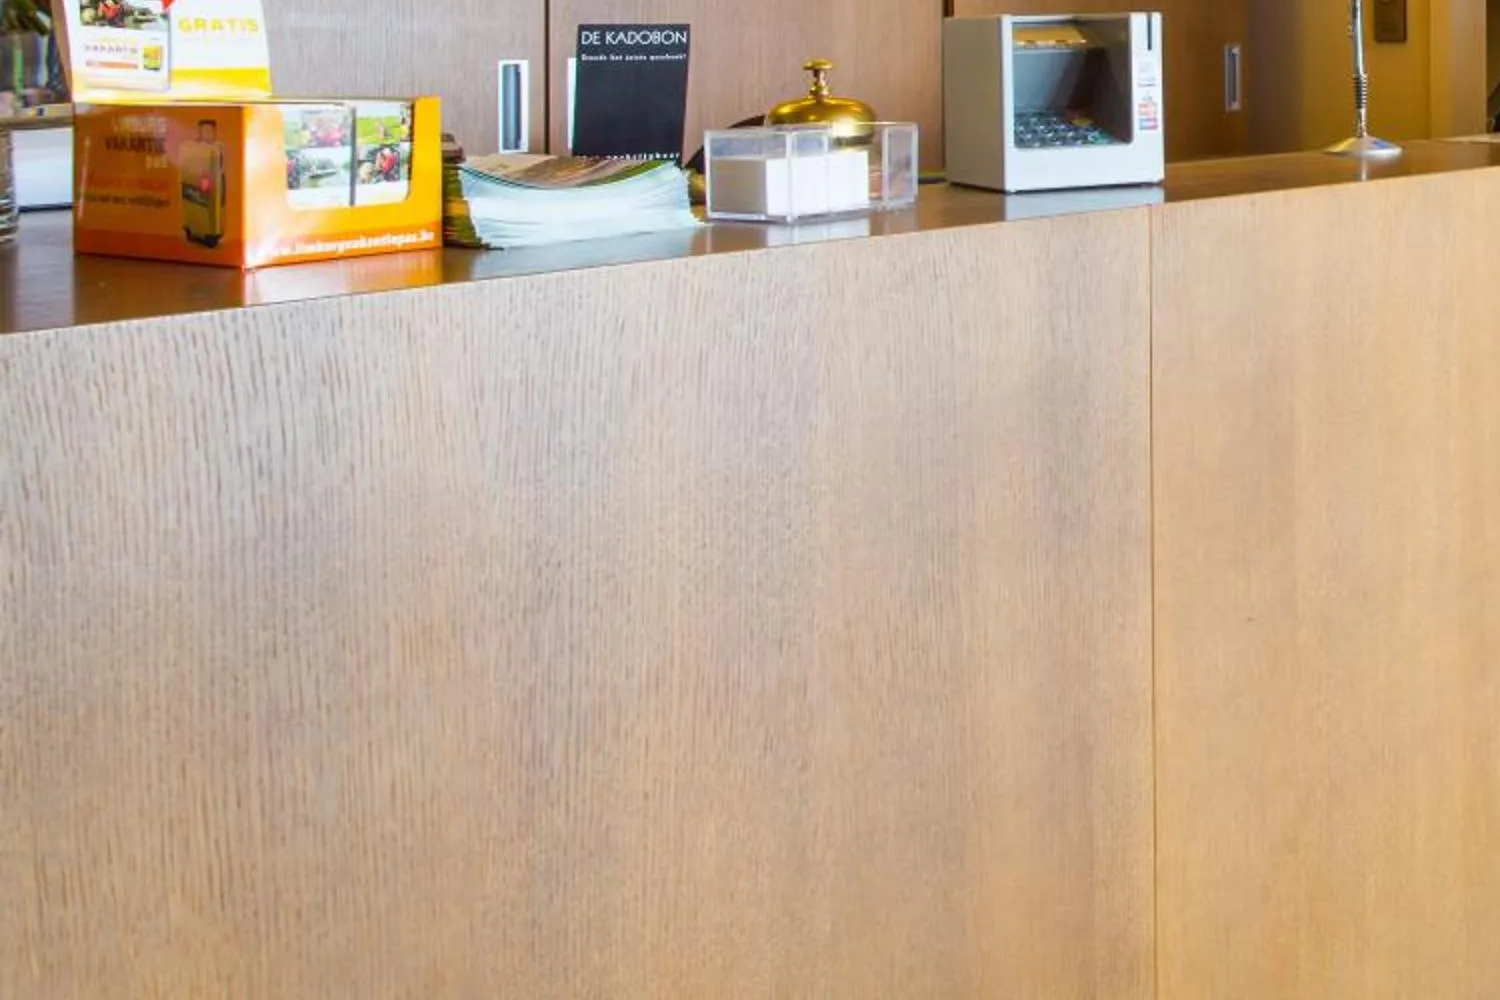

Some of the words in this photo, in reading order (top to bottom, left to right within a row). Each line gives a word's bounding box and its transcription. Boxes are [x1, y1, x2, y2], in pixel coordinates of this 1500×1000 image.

[178, 18, 260, 33] GRATIS
[581, 31, 600, 45] DE
[605, 30, 687, 45] KADOBON
